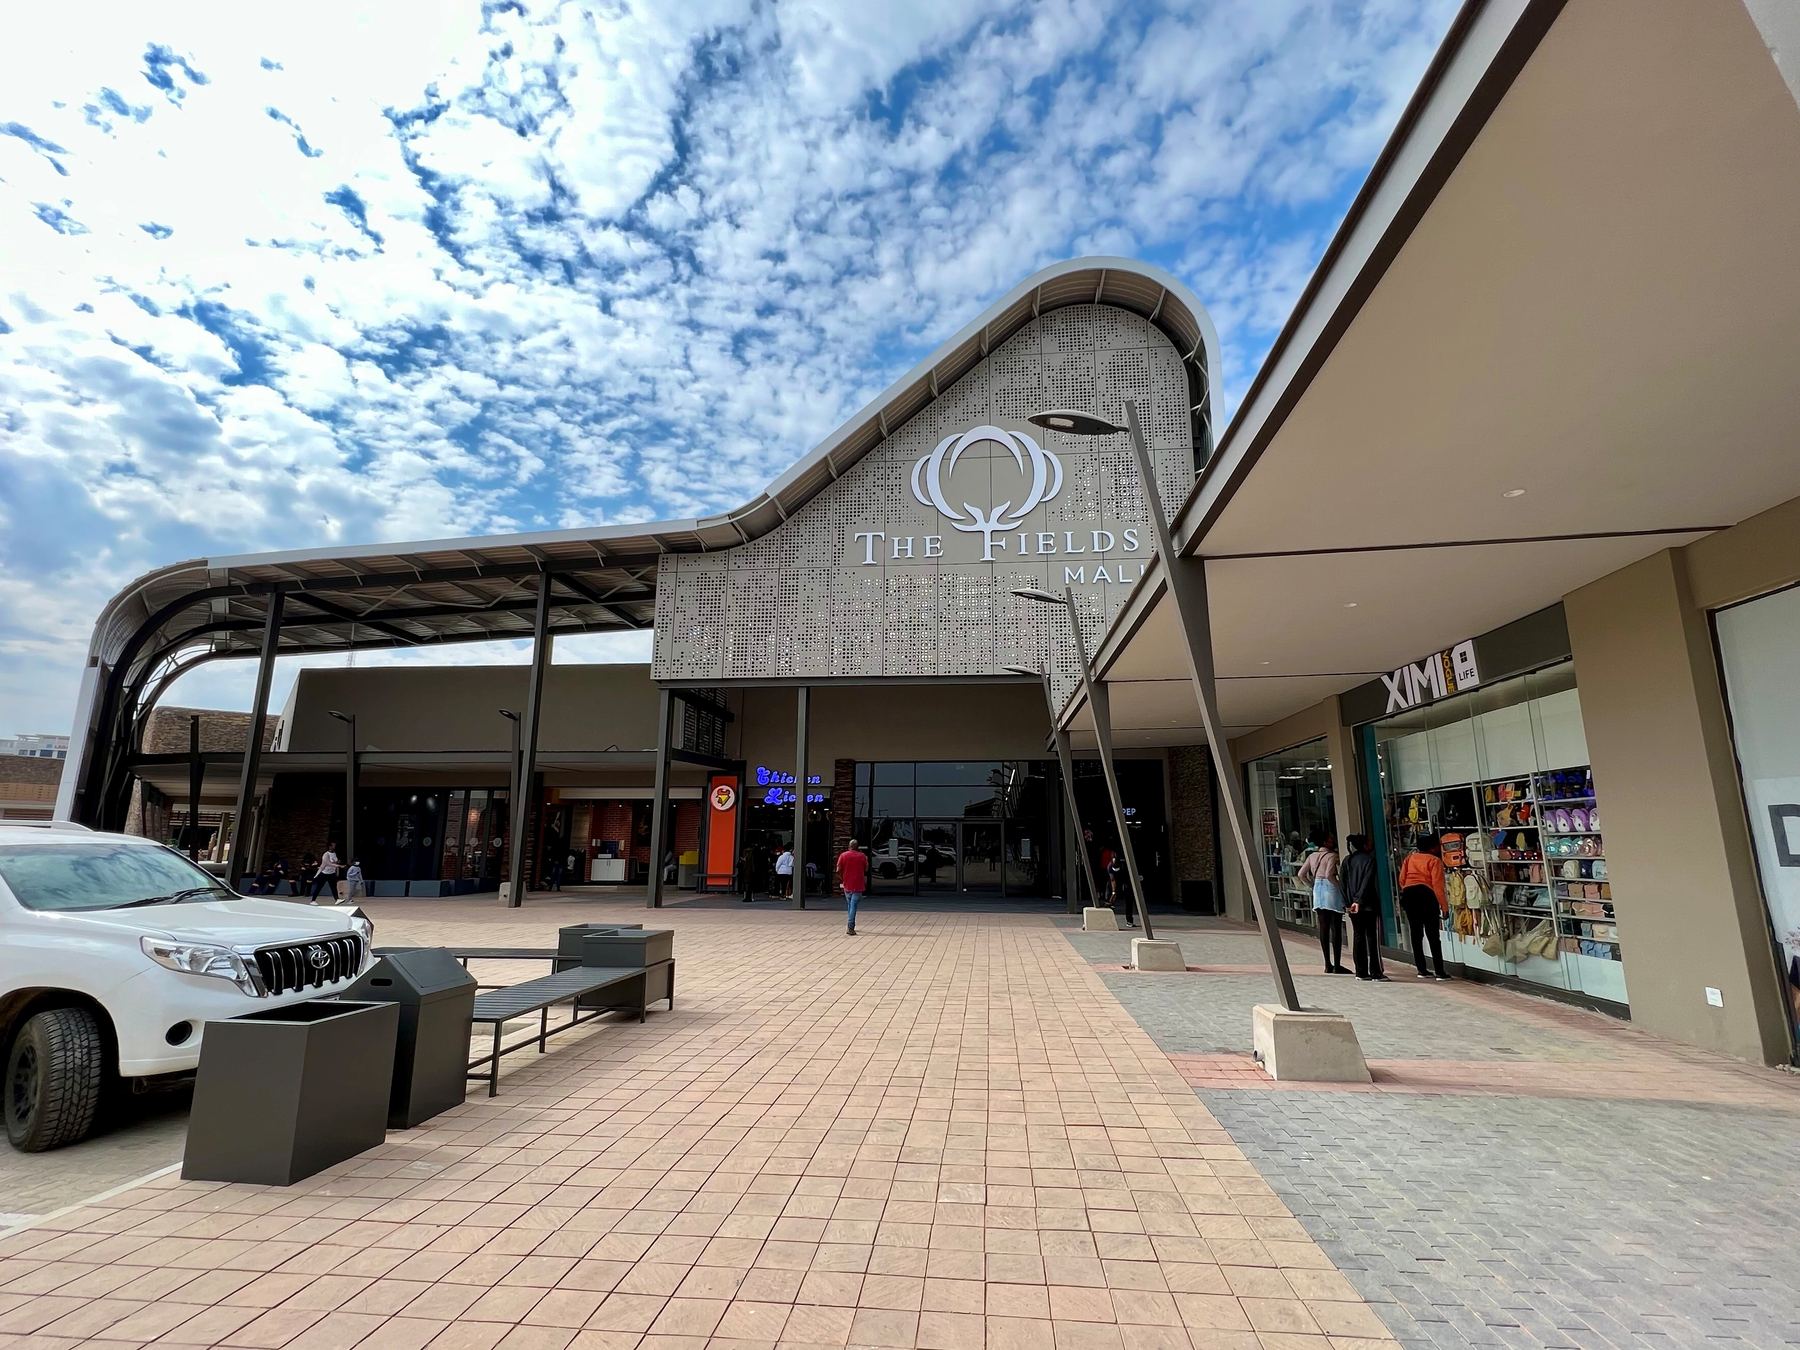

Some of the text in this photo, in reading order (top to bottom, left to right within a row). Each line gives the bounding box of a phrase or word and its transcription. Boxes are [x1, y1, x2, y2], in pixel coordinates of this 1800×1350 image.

[854, 528, 1140, 565] THE FIELDS
[1380, 652, 1449, 714] XIMI
[1442, 650, 1456, 694] VOGUE
[1458, 667, 1476, 681] LIFE
[764, 787, 824, 805] Licen
